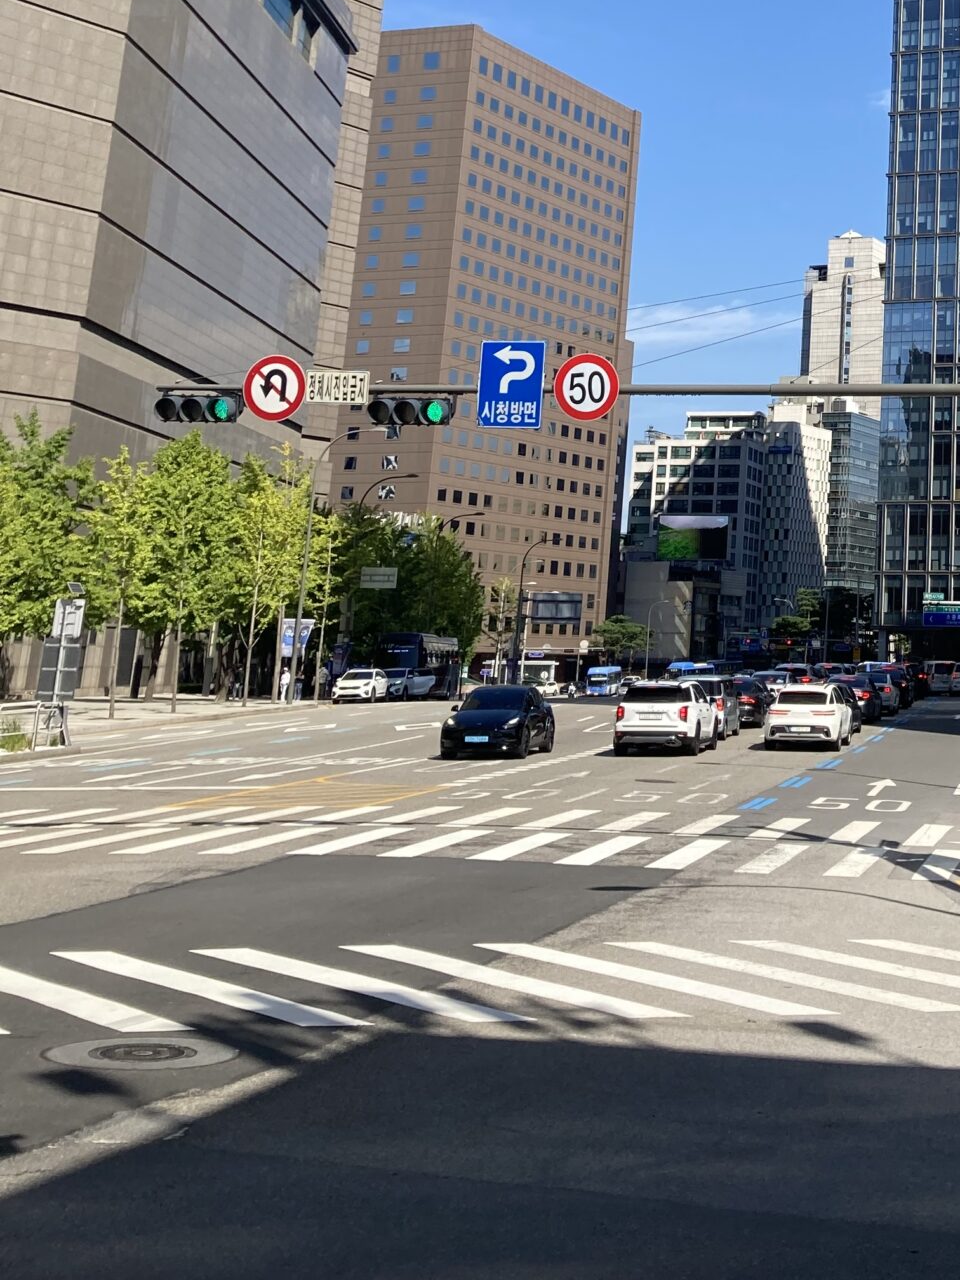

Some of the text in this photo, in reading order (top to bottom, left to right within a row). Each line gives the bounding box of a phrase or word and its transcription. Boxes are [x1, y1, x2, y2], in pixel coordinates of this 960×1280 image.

[308, 373, 366, 401] 정체시진입금지
[569, 371, 605, 404] 50
[481, 400, 537, 423] 시청방면
[613, 790, 729, 805] 50
[806, 796, 913, 812] 50
